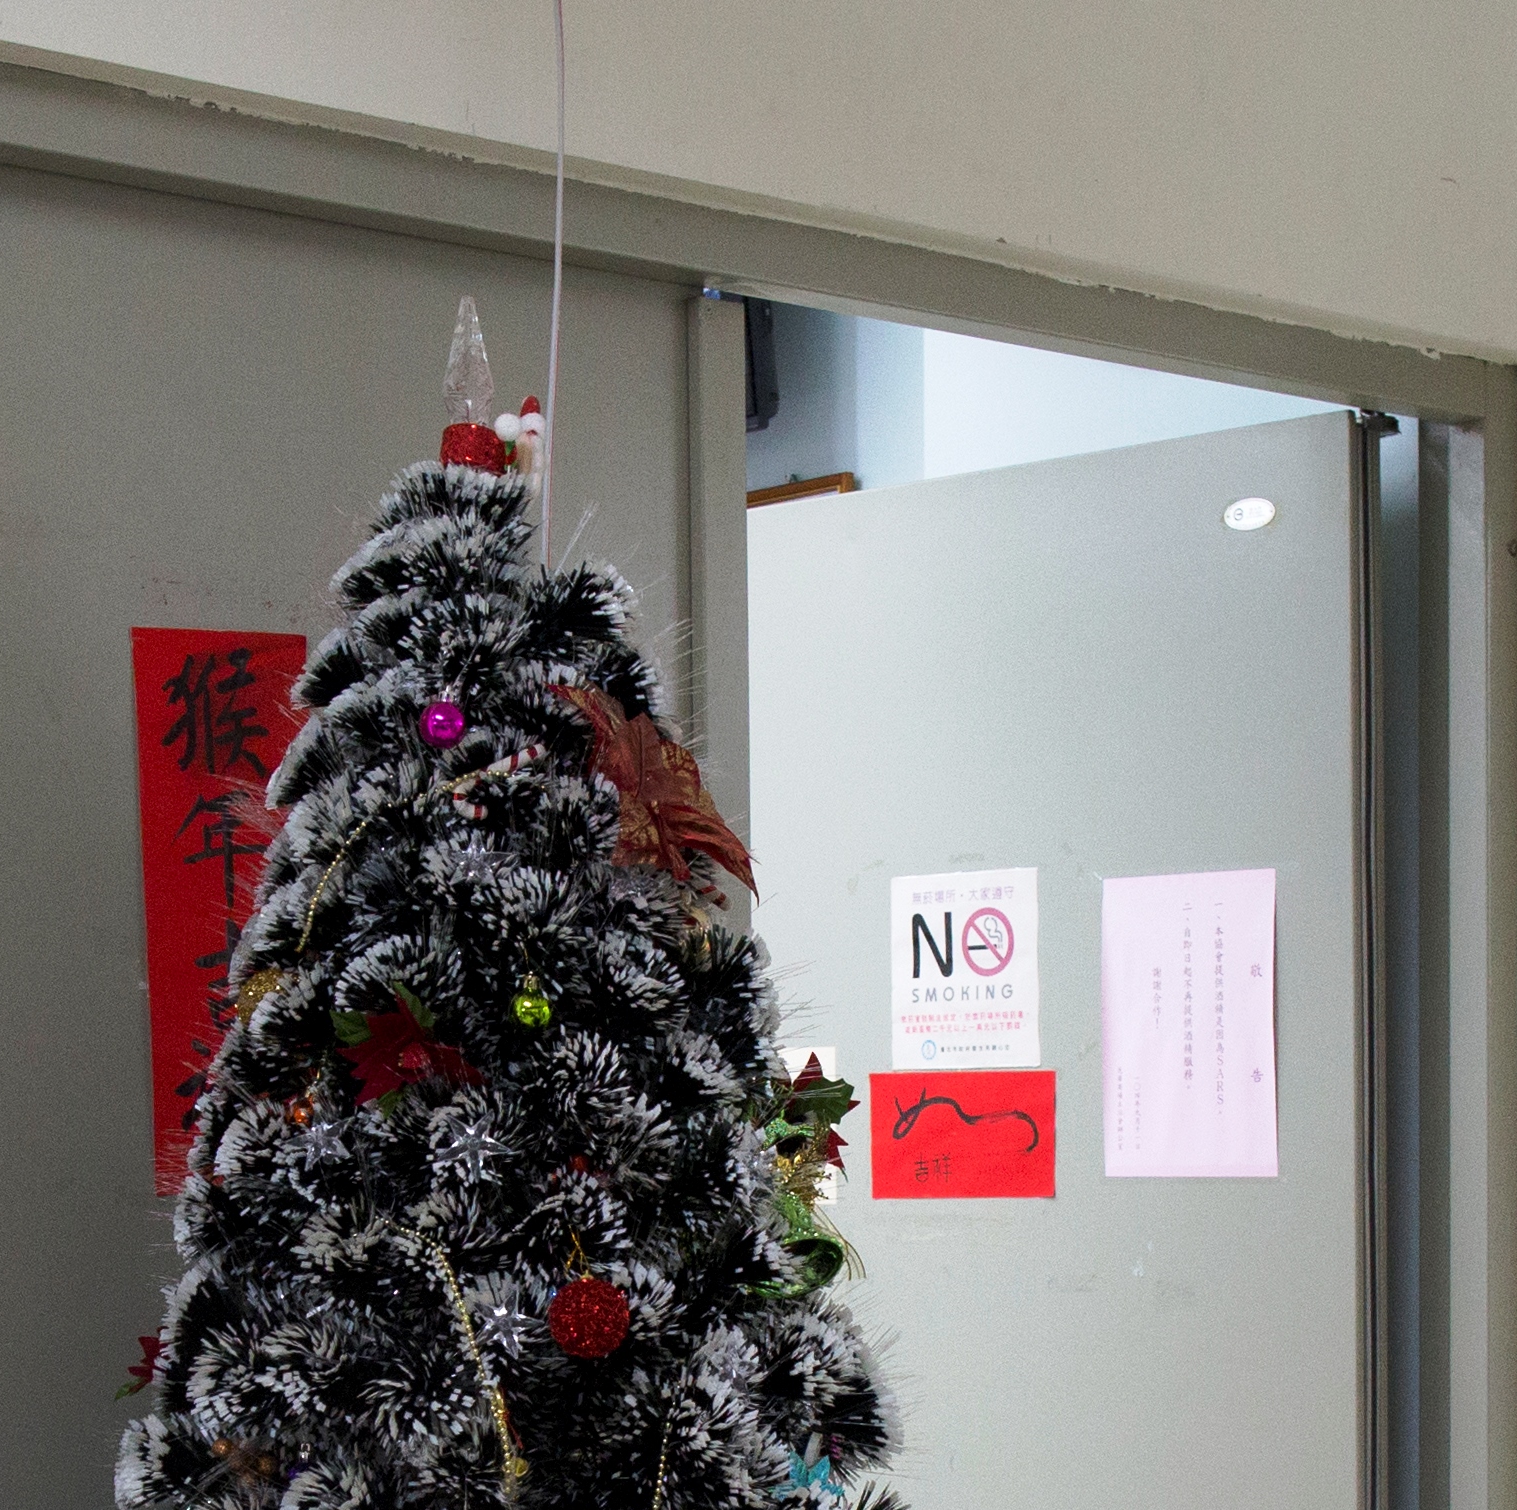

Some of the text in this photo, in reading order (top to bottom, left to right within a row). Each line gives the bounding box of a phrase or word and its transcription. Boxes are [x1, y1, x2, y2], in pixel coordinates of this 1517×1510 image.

[161, 647, 270, 1131] 猴年
[912, 984, 1014, 1003] SMOKING
[914, 1152, 952, 1183] 吉祥
